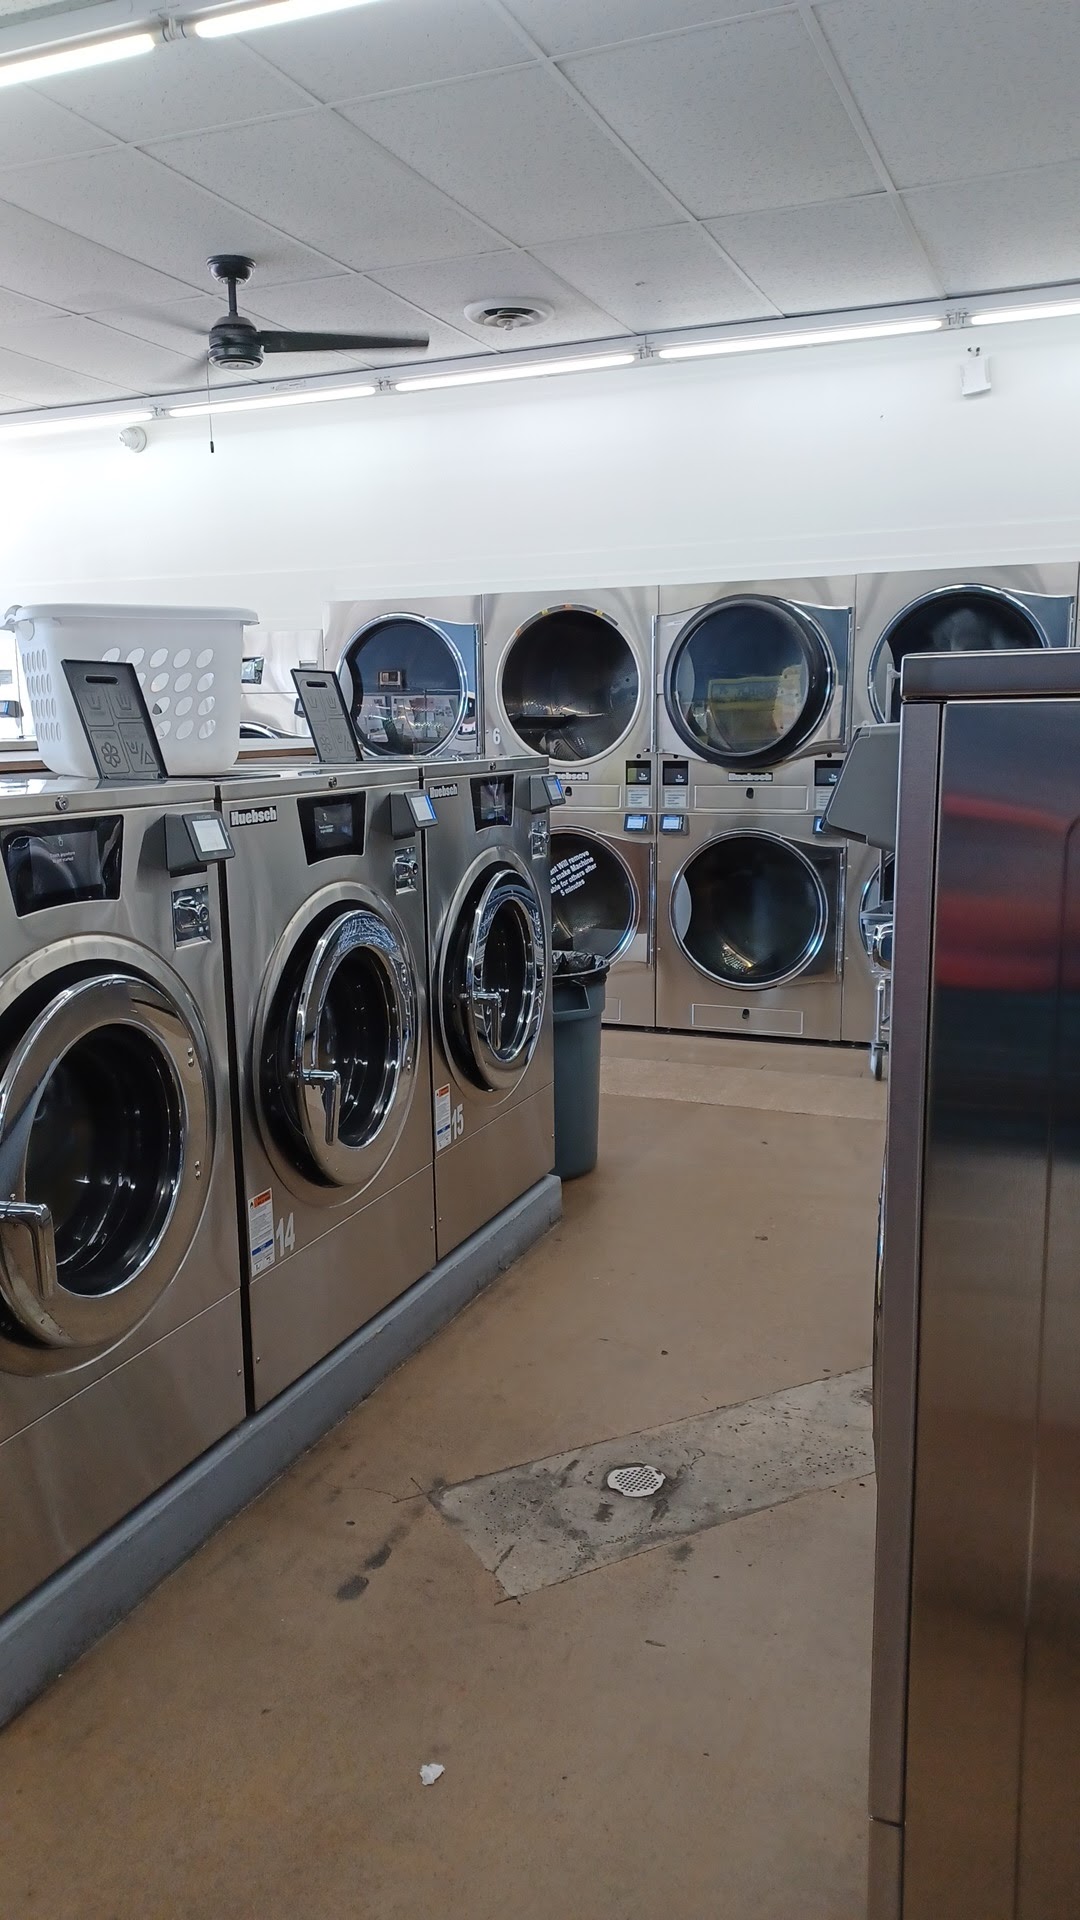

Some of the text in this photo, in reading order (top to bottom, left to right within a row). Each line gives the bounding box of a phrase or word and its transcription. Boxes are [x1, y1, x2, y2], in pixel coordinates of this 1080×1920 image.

[493, 727, 501, 745] 6
[430, 784, 458, 799] Huebsch
[230, 806, 277, 826] Huebsch
[568, 850, 590, 864] remove
[556, 869, 571, 880] make
[570, 856, 594, 872] Machine
[560, 880, 568, 888] for
[568, 870, 586, 882] others
[564, 879, 586, 894] minutes
[452, 1103, 464, 1140] 15
[275, 1211, 296, 1257] 14
